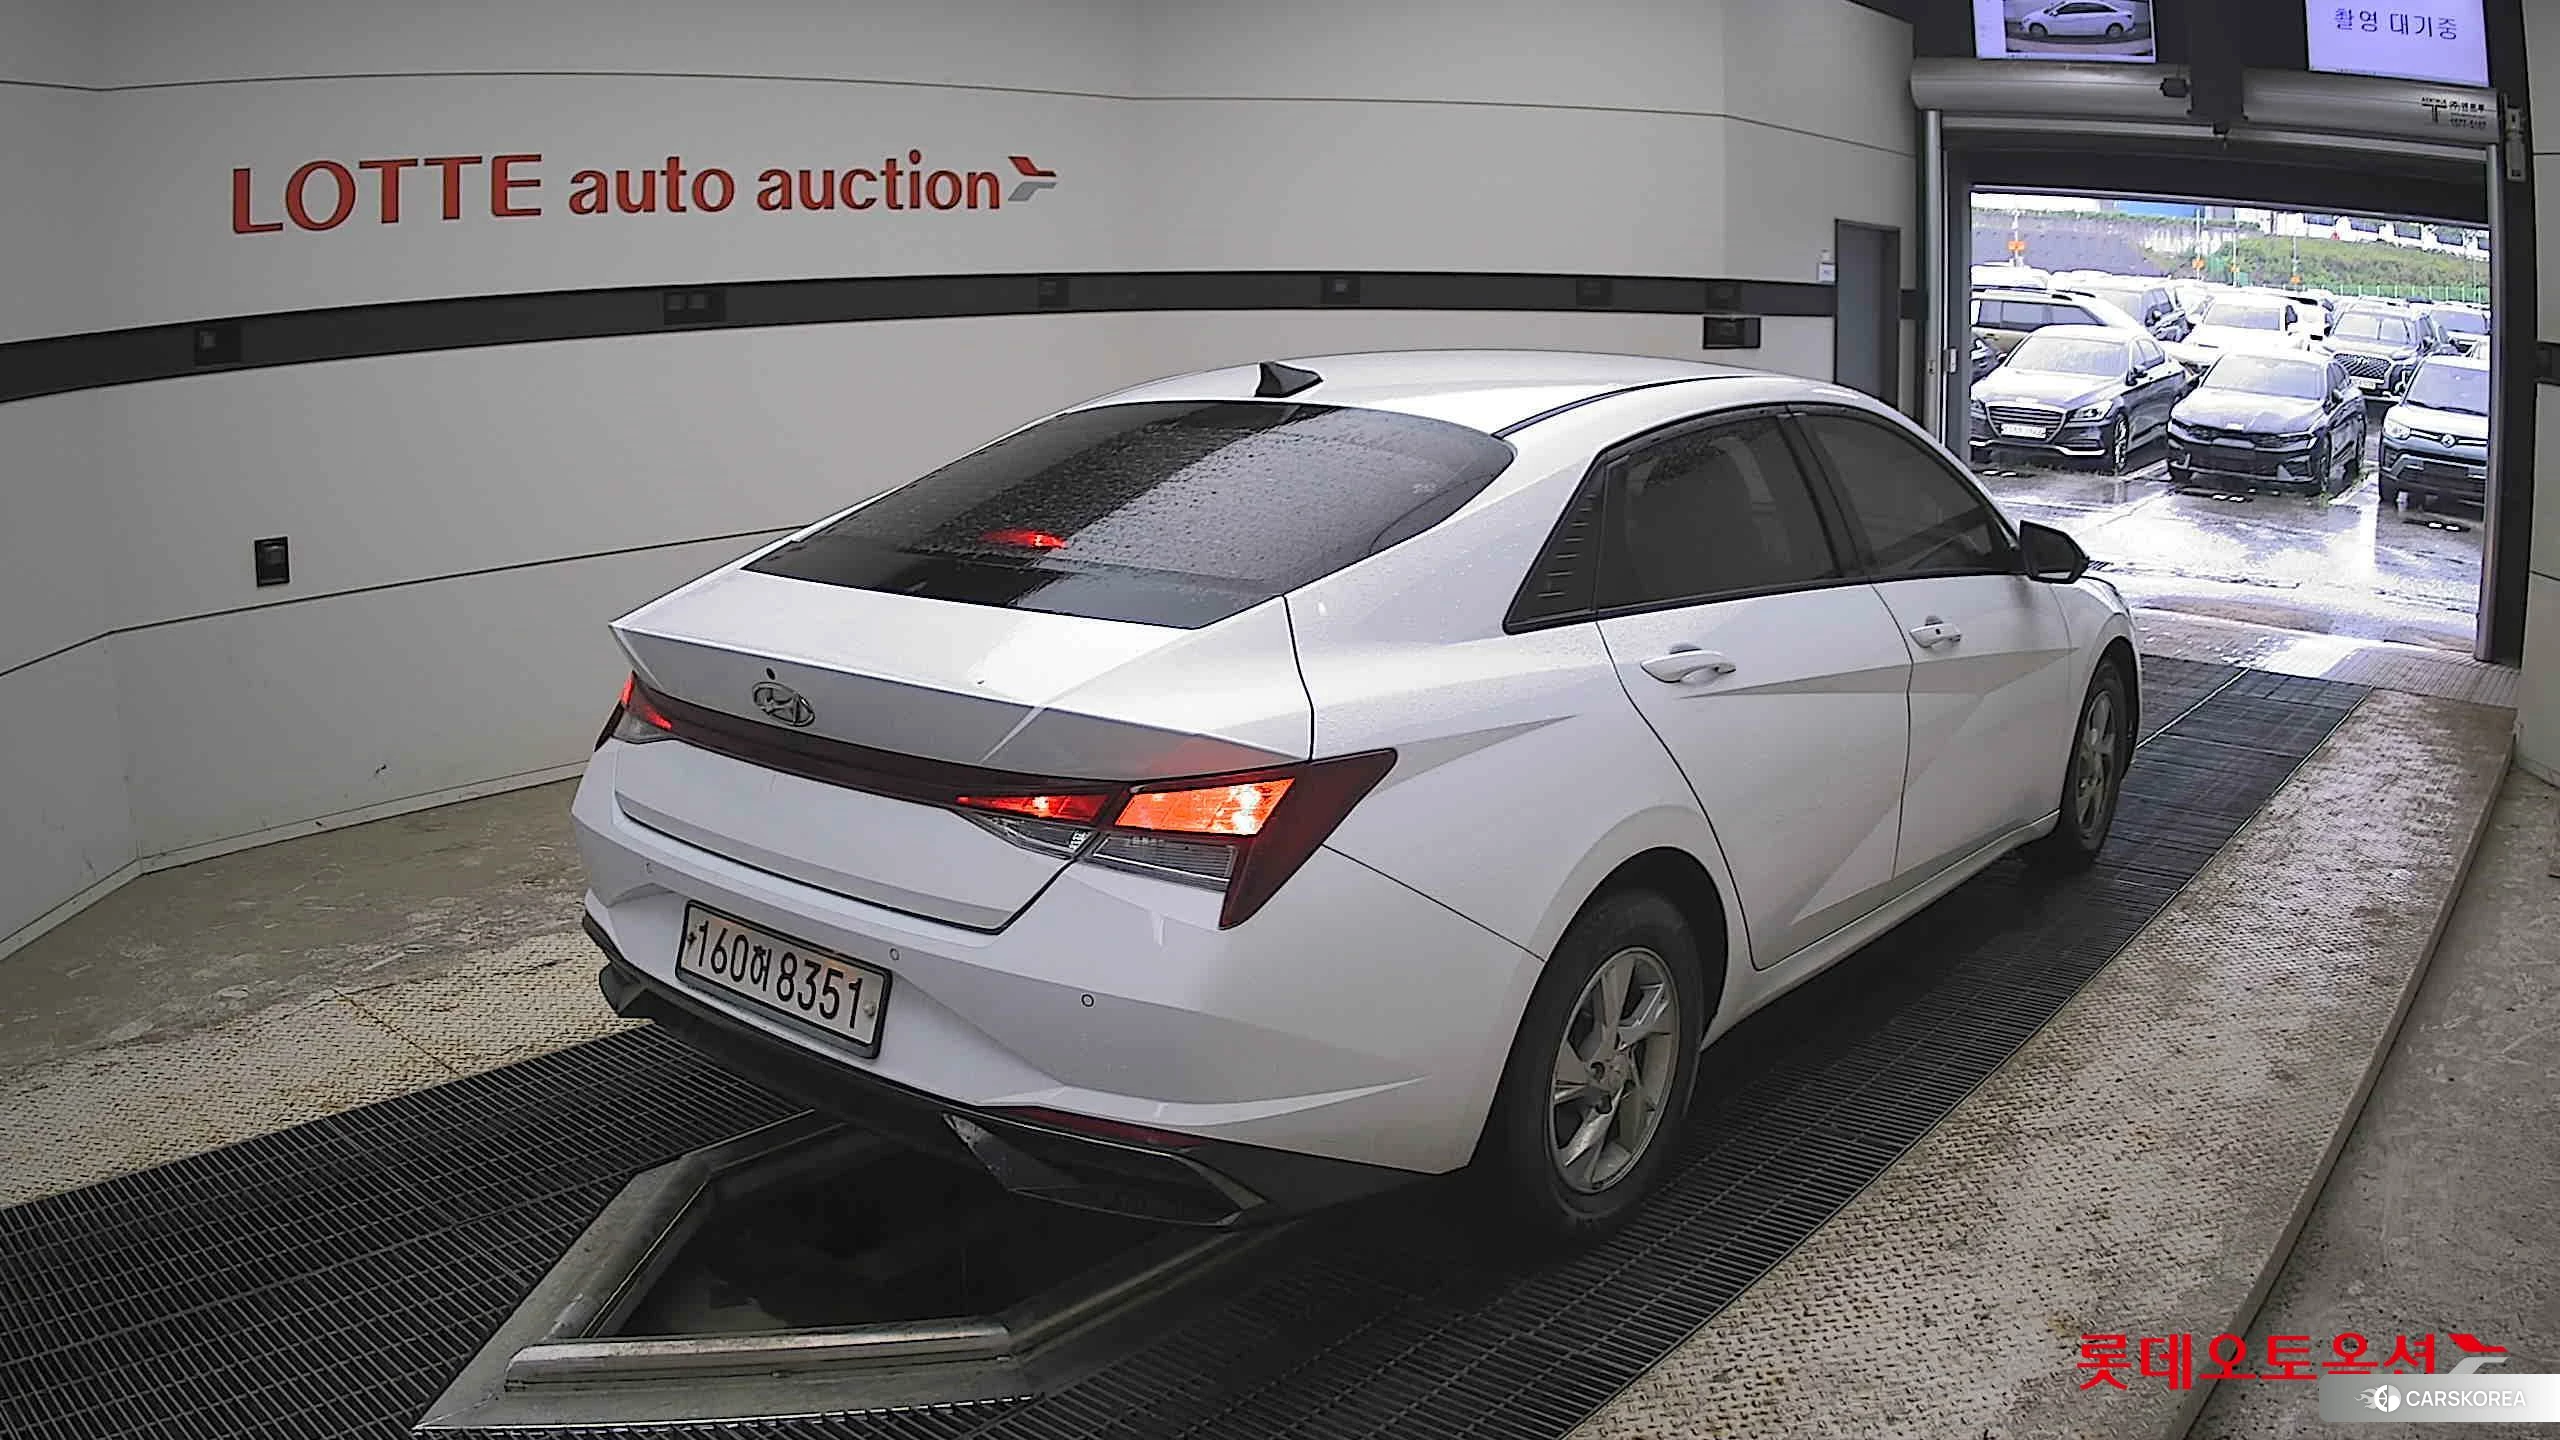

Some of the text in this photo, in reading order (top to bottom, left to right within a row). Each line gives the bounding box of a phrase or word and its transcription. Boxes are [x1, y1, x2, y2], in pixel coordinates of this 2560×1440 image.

[2390, 13, 2457, 40] 대기중
[233, 149, 1001, 234] LOTTE auto auction
